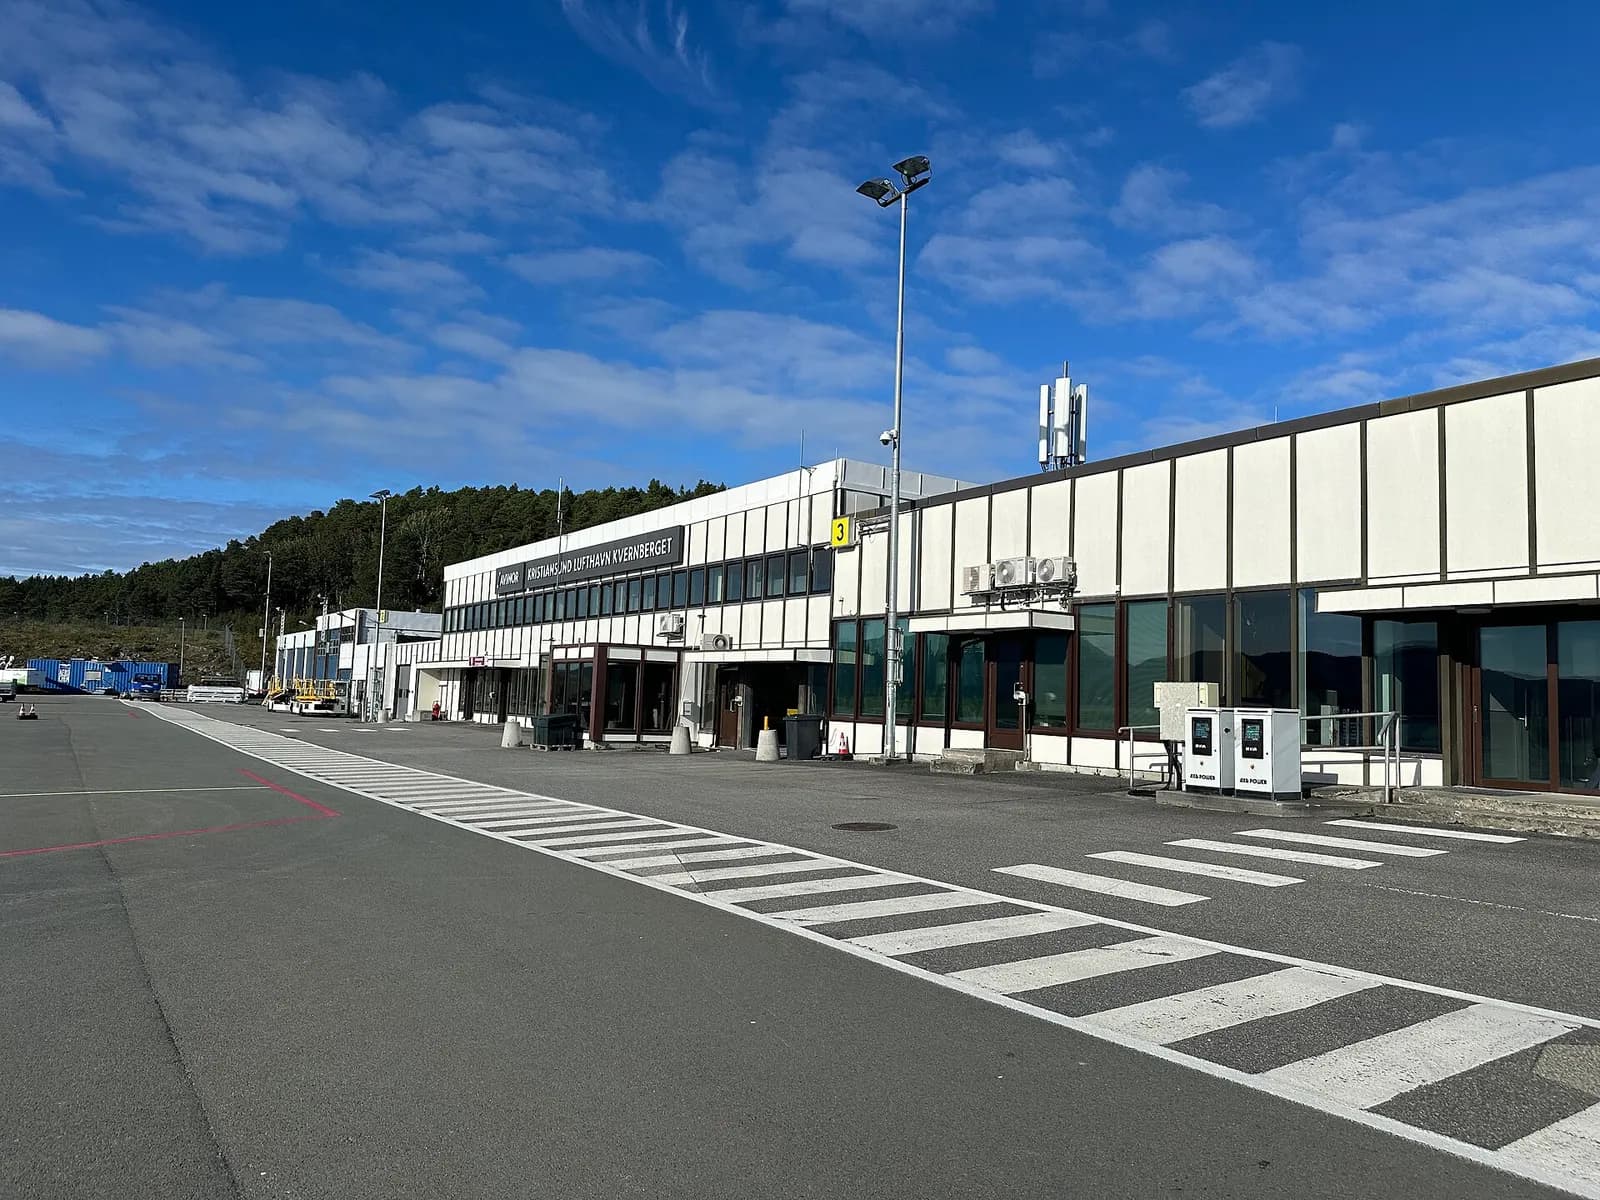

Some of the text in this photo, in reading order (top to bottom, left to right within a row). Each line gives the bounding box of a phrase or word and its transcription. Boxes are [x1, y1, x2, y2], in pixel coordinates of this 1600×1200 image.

[836, 523, 844, 541] 3
[527, 537, 673, 581] KRISTIANSUND LUFTHAVN KVERNBERGET
